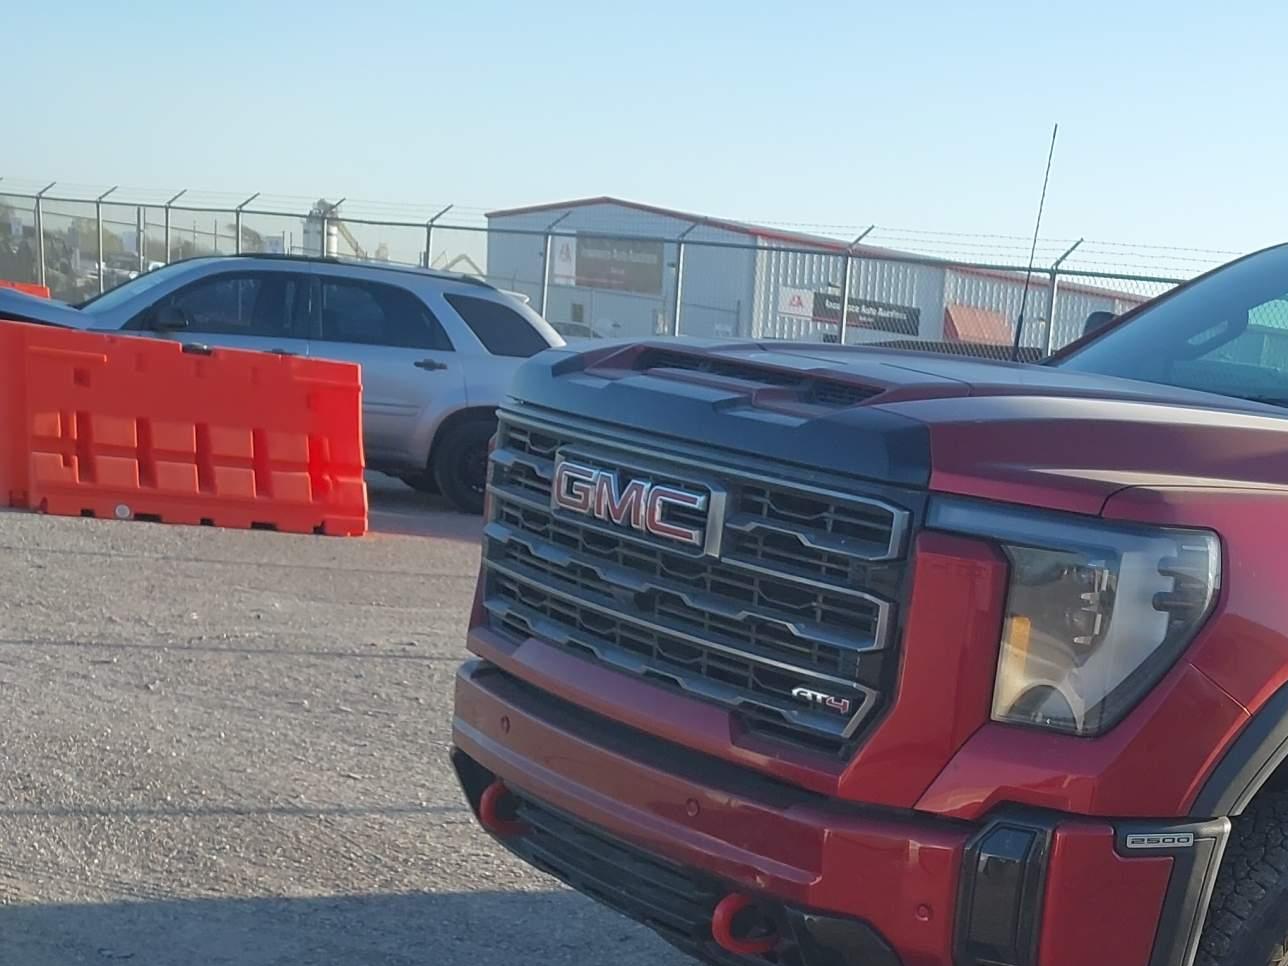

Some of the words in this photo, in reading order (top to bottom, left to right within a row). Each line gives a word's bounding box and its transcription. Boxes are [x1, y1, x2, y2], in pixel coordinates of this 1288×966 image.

[556, 461, 706, 547] GMC
[791, 687, 850, 714] AT4
[1130, 836, 1191, 845] 2500
